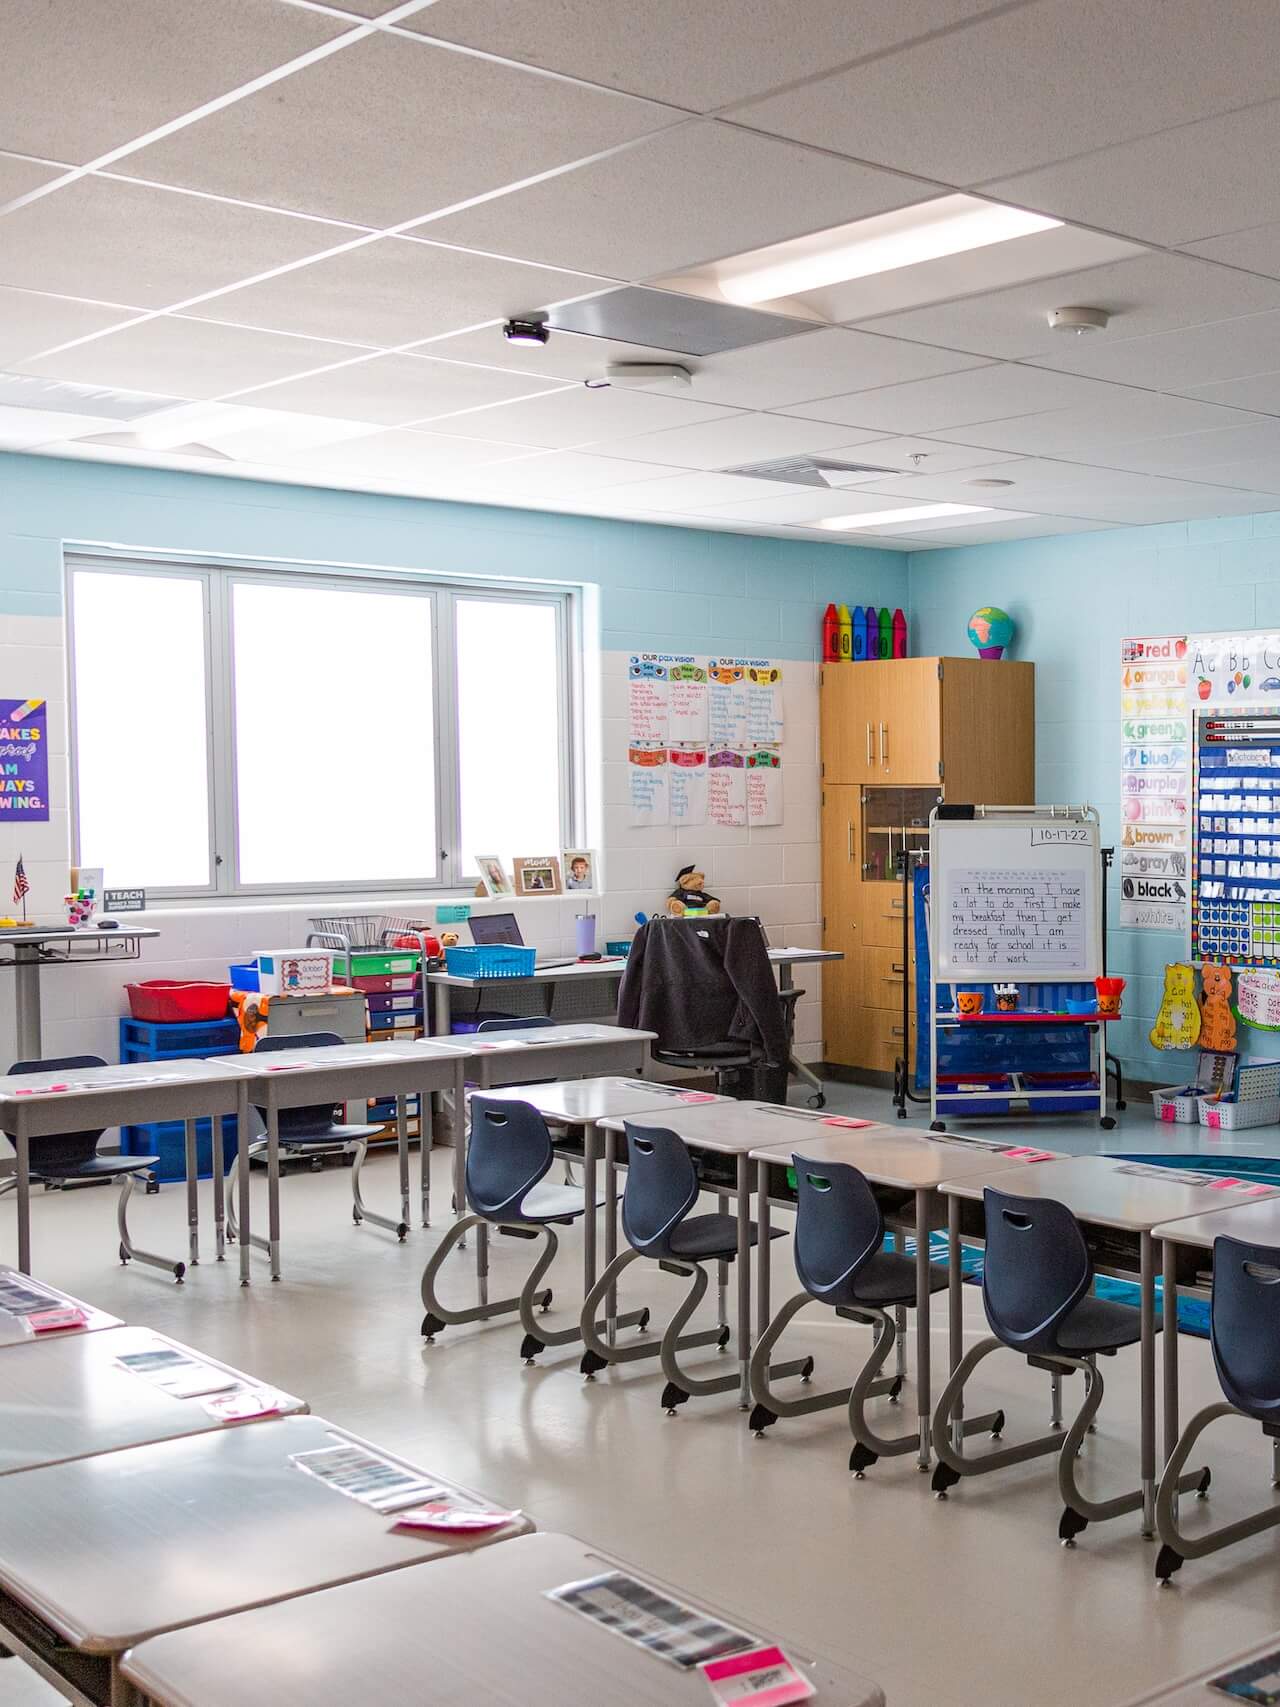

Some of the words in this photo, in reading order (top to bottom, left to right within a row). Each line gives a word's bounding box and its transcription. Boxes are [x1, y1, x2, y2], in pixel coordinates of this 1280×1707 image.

[1145, 640, 1171, 657] red
[1134, 668, 1176, 685] orange
[1137, 722, 1172, 739] green
[1140, 750, 1169, 765] blue
[1138, 775, 1178, 792] purple
[1142, 801, 1172, 819] pink
[1040, 829, 1089, 841] 10-17-22
[1135, 828, 1174, 843] brown
[1140, 858, 1169, 872] gray
[111, 890, 143, 900] TEACH
[960, 886, 970, 895] in
[978, 882, 993, 895] the
[997, 886, 1035, 898] morning
[1044, 882, 1052, 895] I
[1060, 884, 1081, 896] have
[1137, 881, 1172, 897] black
[966, 897, 977, 908] lot
[985, 897, 995, 909] to
[1003, 897, 1015, 909] do
[1024, 896, 1045, 909] first
[1052, 896, 1059, 909] I
[1062, 899, 1081, 909] make
[952, 914, 964, 926] my
[972, 910, 1006, 922] breakfast
[1016, 910, 1037, 922] then
[1041, 910, 1048, 922] I
[1057, 912, 1073, 925] get
[952, 925, 988, 936] dressed
[998, 924, 1025, 938] finally
[1032, 924, 1040, 936] I
[1049, 928, 1064, 936] am
[954, 938, 979, 952] ready
[986, 938, 999, 949] for
[1007, 938, 1034, 950] school
[1042, 939, 1052, 950] it
[1059, 939, 1067, 950] is
[966, 952, 979, 963] lot
[987, 951, 999, 963] of
